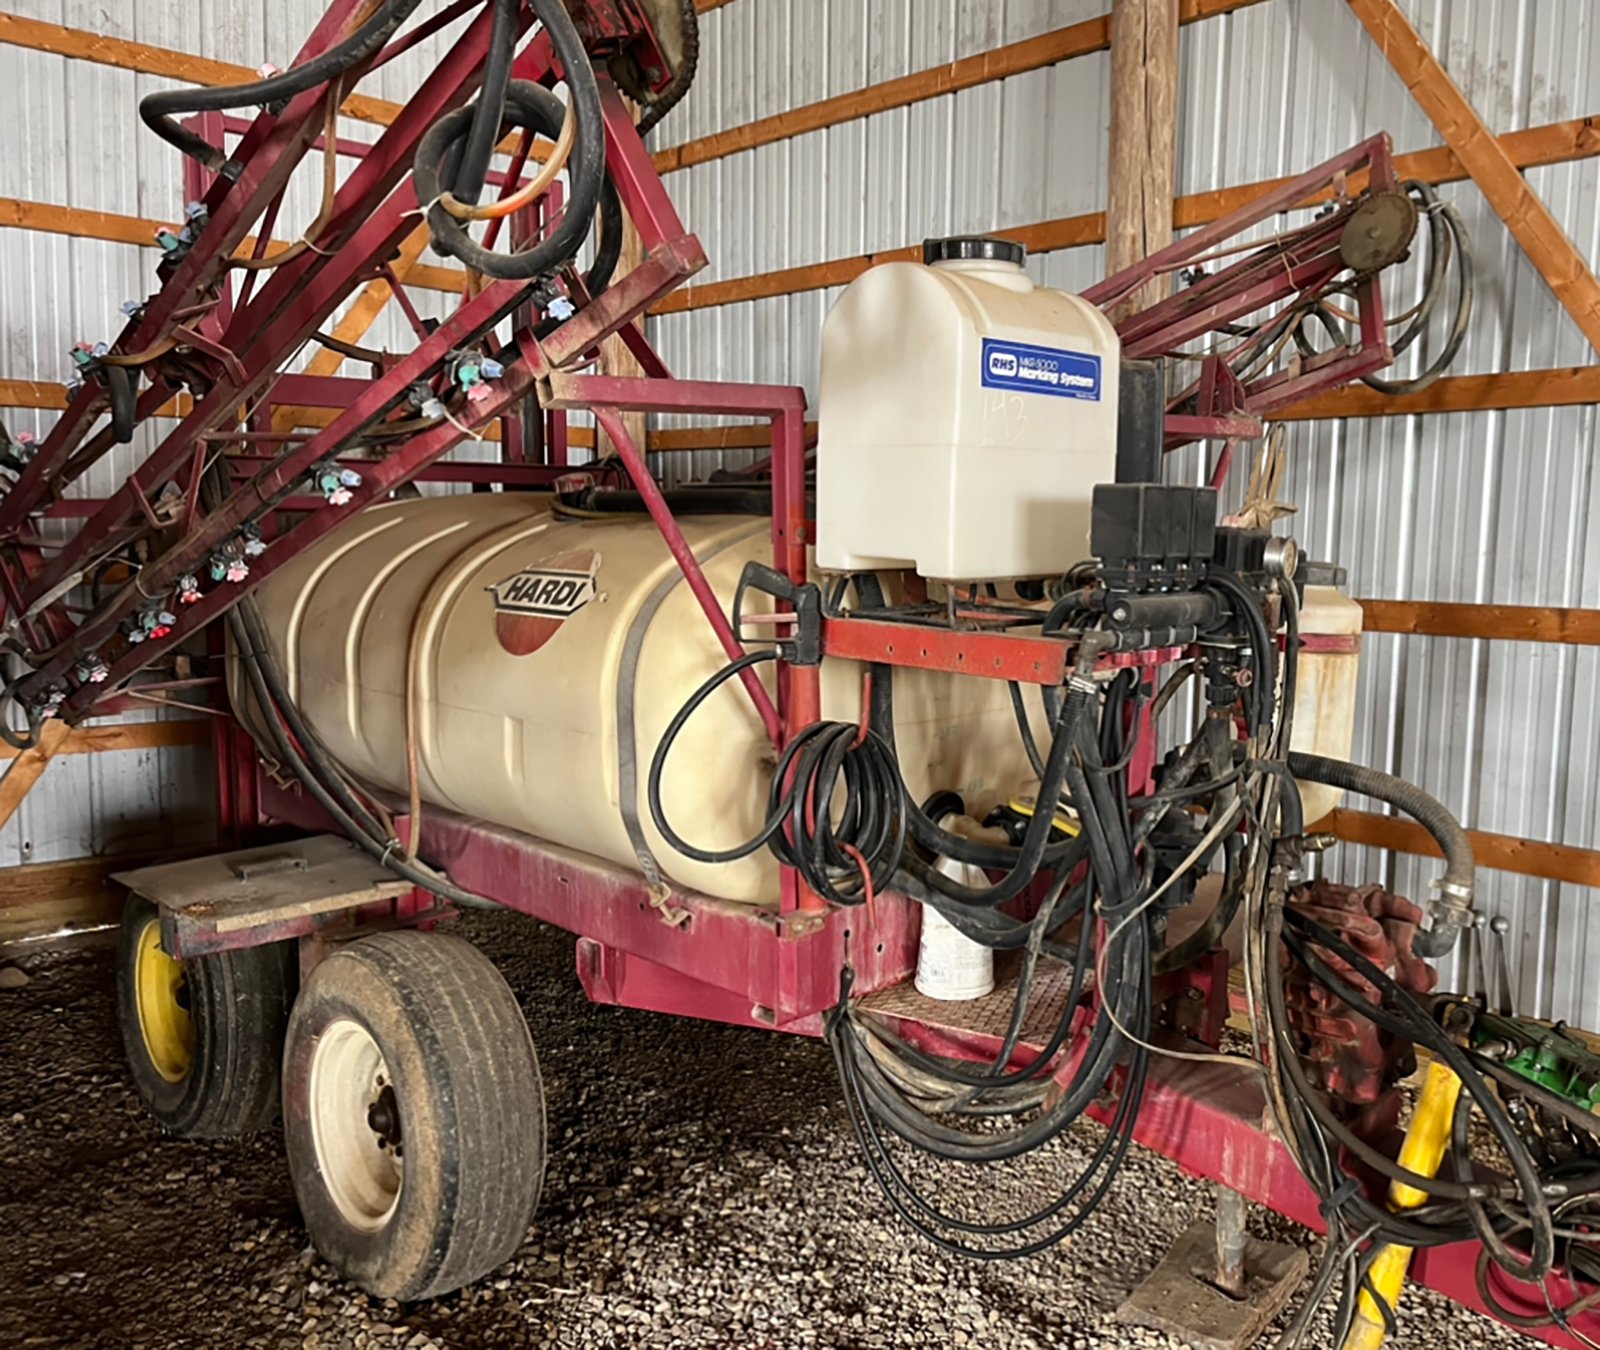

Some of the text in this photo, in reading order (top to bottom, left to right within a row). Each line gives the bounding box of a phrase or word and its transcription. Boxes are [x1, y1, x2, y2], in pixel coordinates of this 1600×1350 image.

[991, 357, 1015, 371] RHS
[1018, 367, 1094, 388] Marking System
[503, 577, 587, 606] HARDI
